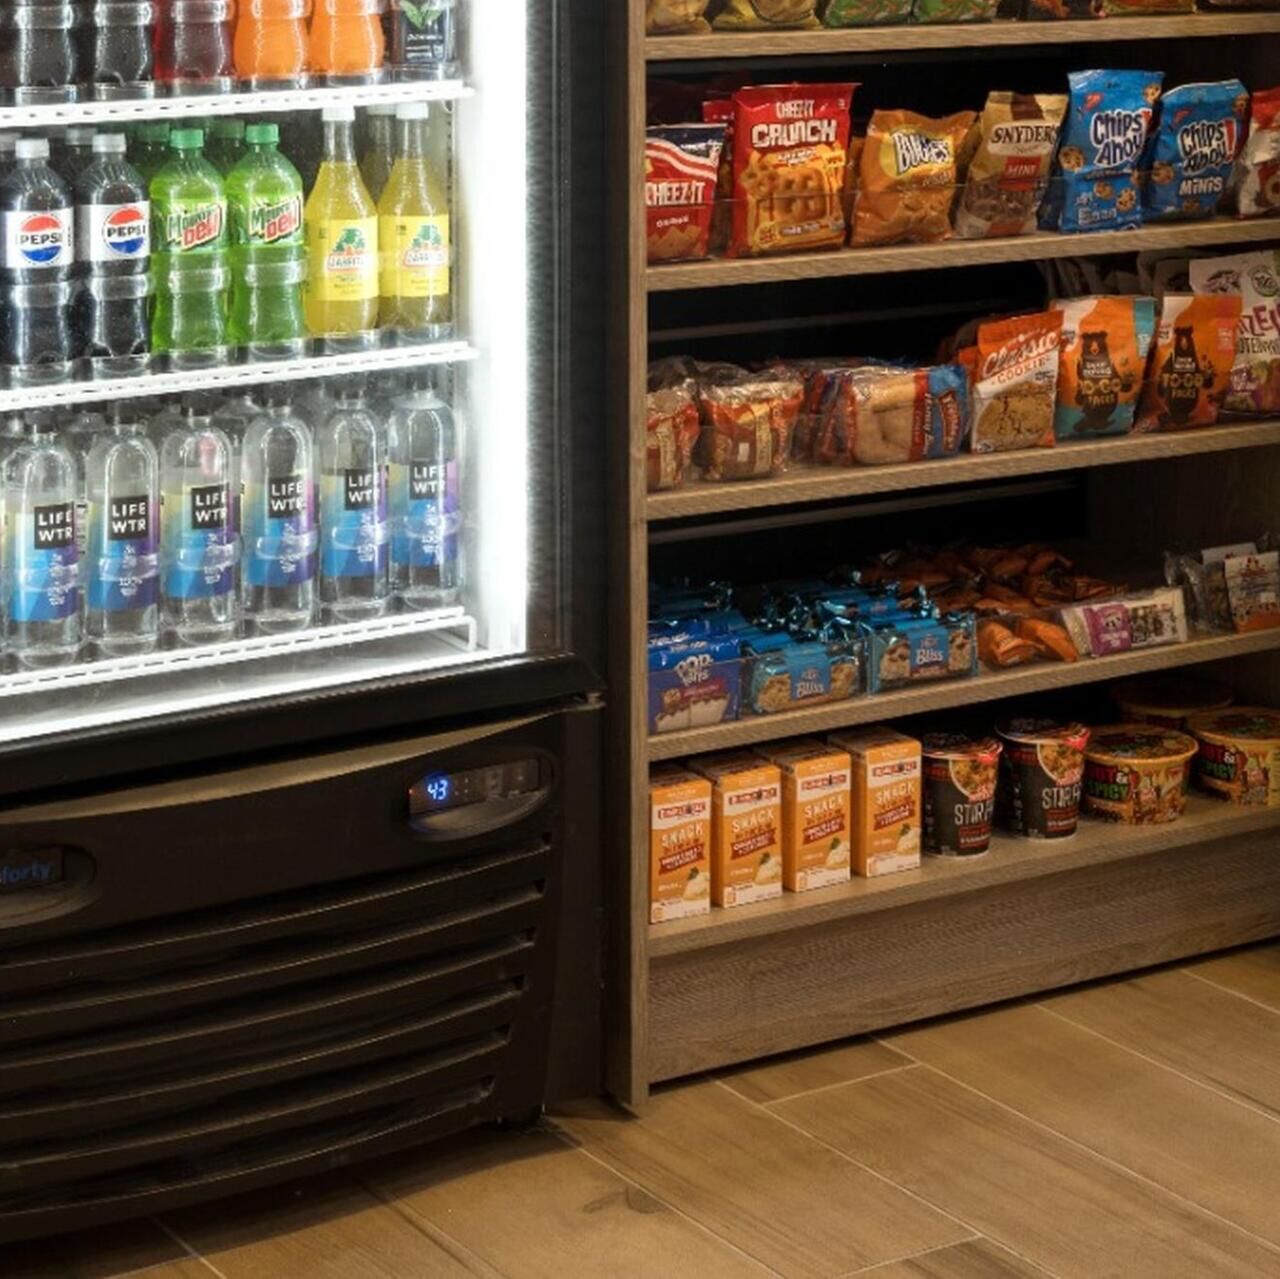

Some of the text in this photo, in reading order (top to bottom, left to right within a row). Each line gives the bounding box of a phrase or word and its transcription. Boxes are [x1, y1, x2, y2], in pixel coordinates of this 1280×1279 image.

[751, 120, 837, 148] CRUNCH
[1093, 109, 1144, 140] Chips
[1178, 120, 1225, 152] Chips
[20, 234, 62, 246] PEPSI
[106, 225, 146, 238] PEPSI
[982, 331, 1058, 378] Classic
[997, 357, 1046, 385] COOKIE
[195, 489, 228, 507] LIFE
[272, 482, 303, 497] LIFE
[38, 509, 72, 526] LIFE
[112, 502, 146, 518] LIFE
[39, 527, 72, 542] WTR
[112, 519, 146, 534] WTR
[427, 778, 449, 801] 43
[732, 808, 775, 832] SNACK
[662, 822, 704, 847] SNACK
